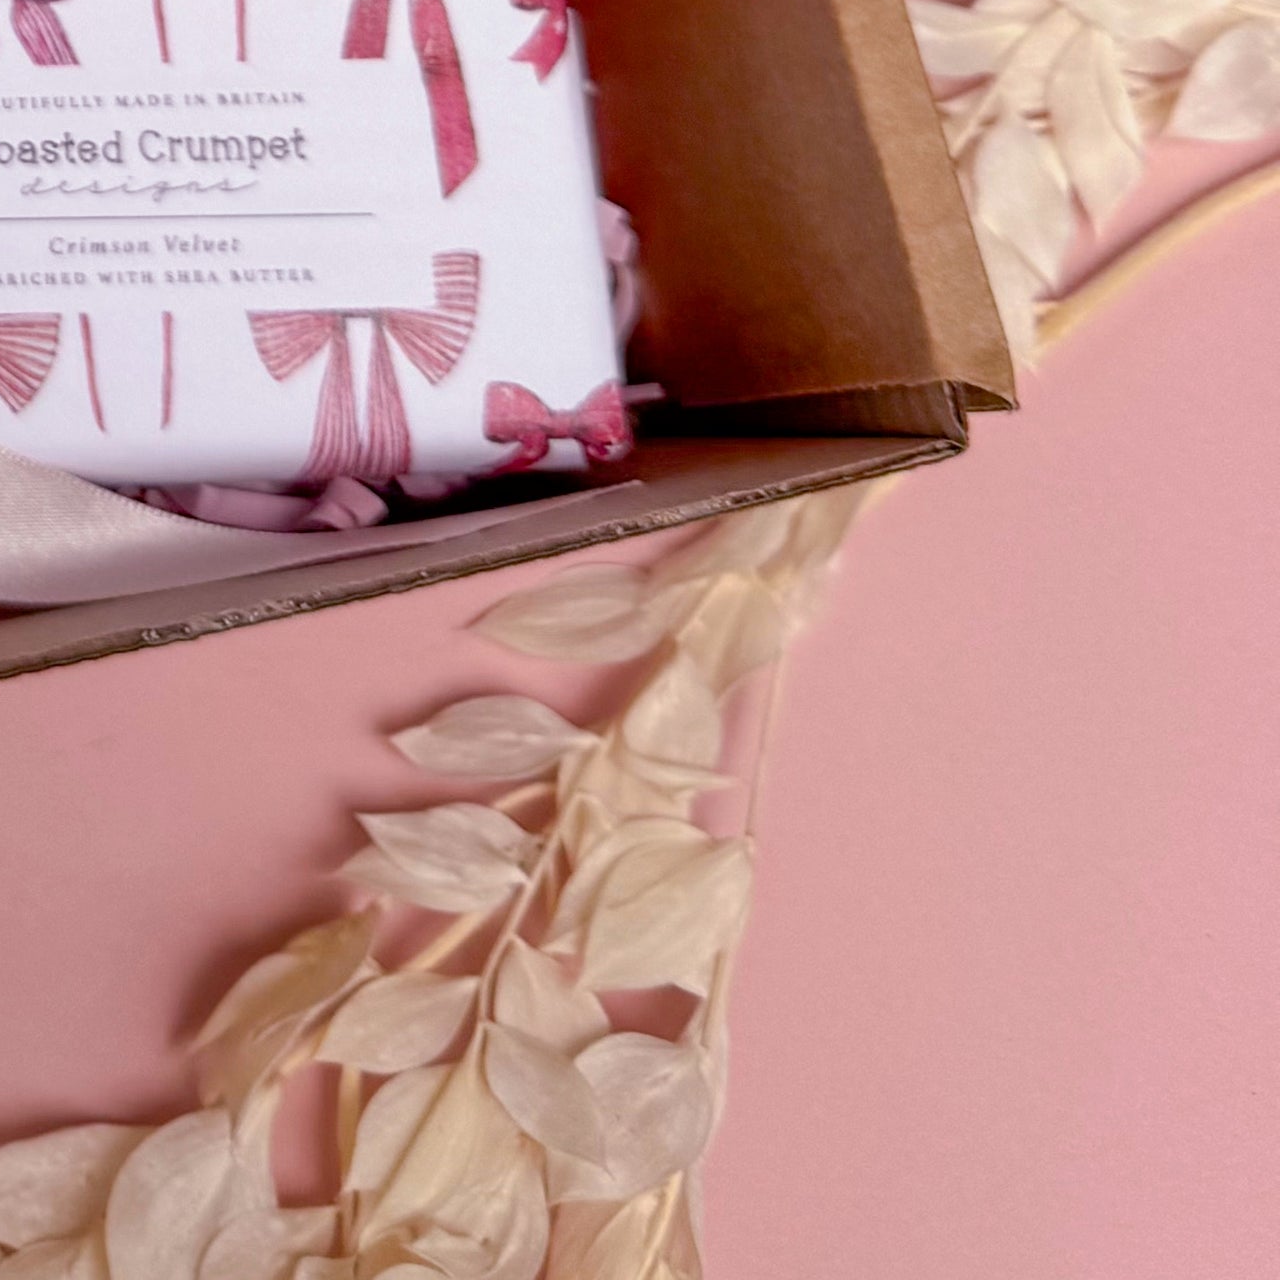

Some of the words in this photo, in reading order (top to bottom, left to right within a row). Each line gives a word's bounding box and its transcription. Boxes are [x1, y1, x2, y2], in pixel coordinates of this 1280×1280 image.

[115, 93, 174, 108] MADE
[184, 93, 207, 107] IN
[217, 92, 305, 107] BRITAIN
[138, 128, 307, 171] Crumpet
[20, 176, 258, 203] designs
[48, 237, 151, 255] Crimson
[163, 234, 241, 253] Velvet
[97, 270, 154, 285] WITH
[164, 270, 219, 284] SHEA
[229, 268, 315, 283] BUTTER
